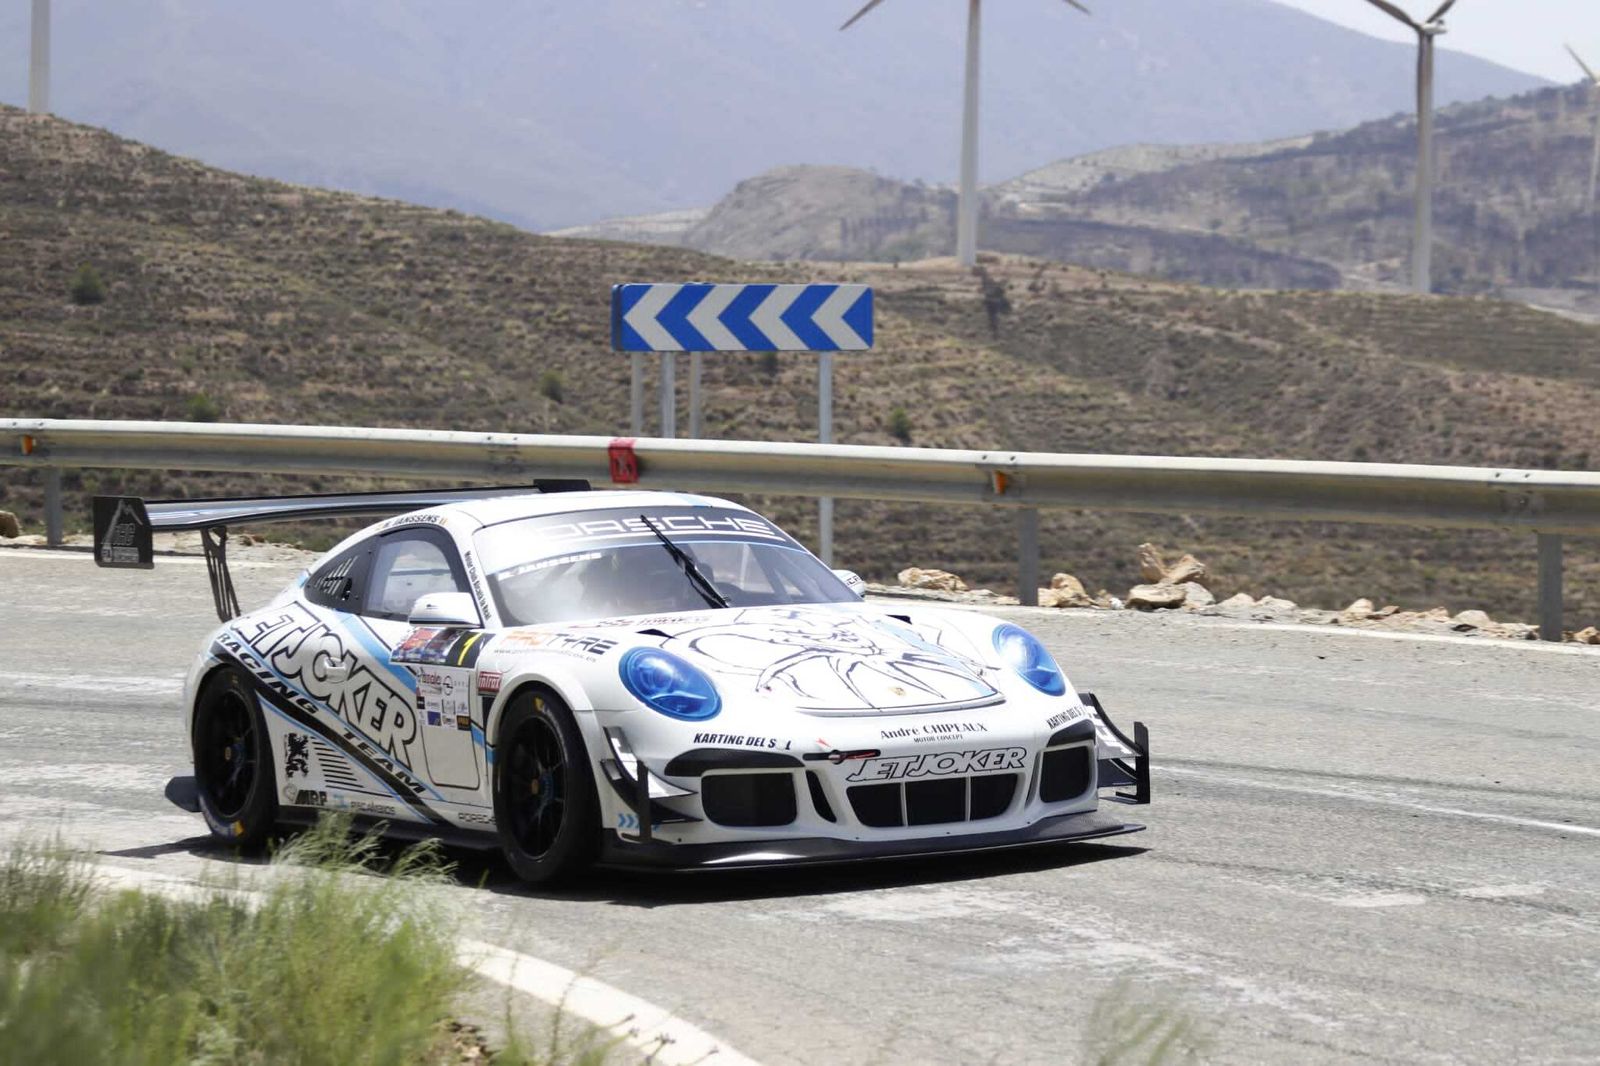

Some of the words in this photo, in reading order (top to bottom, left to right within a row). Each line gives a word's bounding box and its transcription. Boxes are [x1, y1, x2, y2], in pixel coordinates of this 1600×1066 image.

[217, 632, 319, 715] RACING
[693, 732, 745, 746] KARTING
[745, 736, 766, 747] DEL
[913, 736, 936, 744] MOTOR
[936, 733, 964, 742] CONCEPT
[922, 722, 988, 736] CHIPEAUX
[343, 727, 427, 796] TEAM
[845, 746, 1027, 783] JETJOKER
